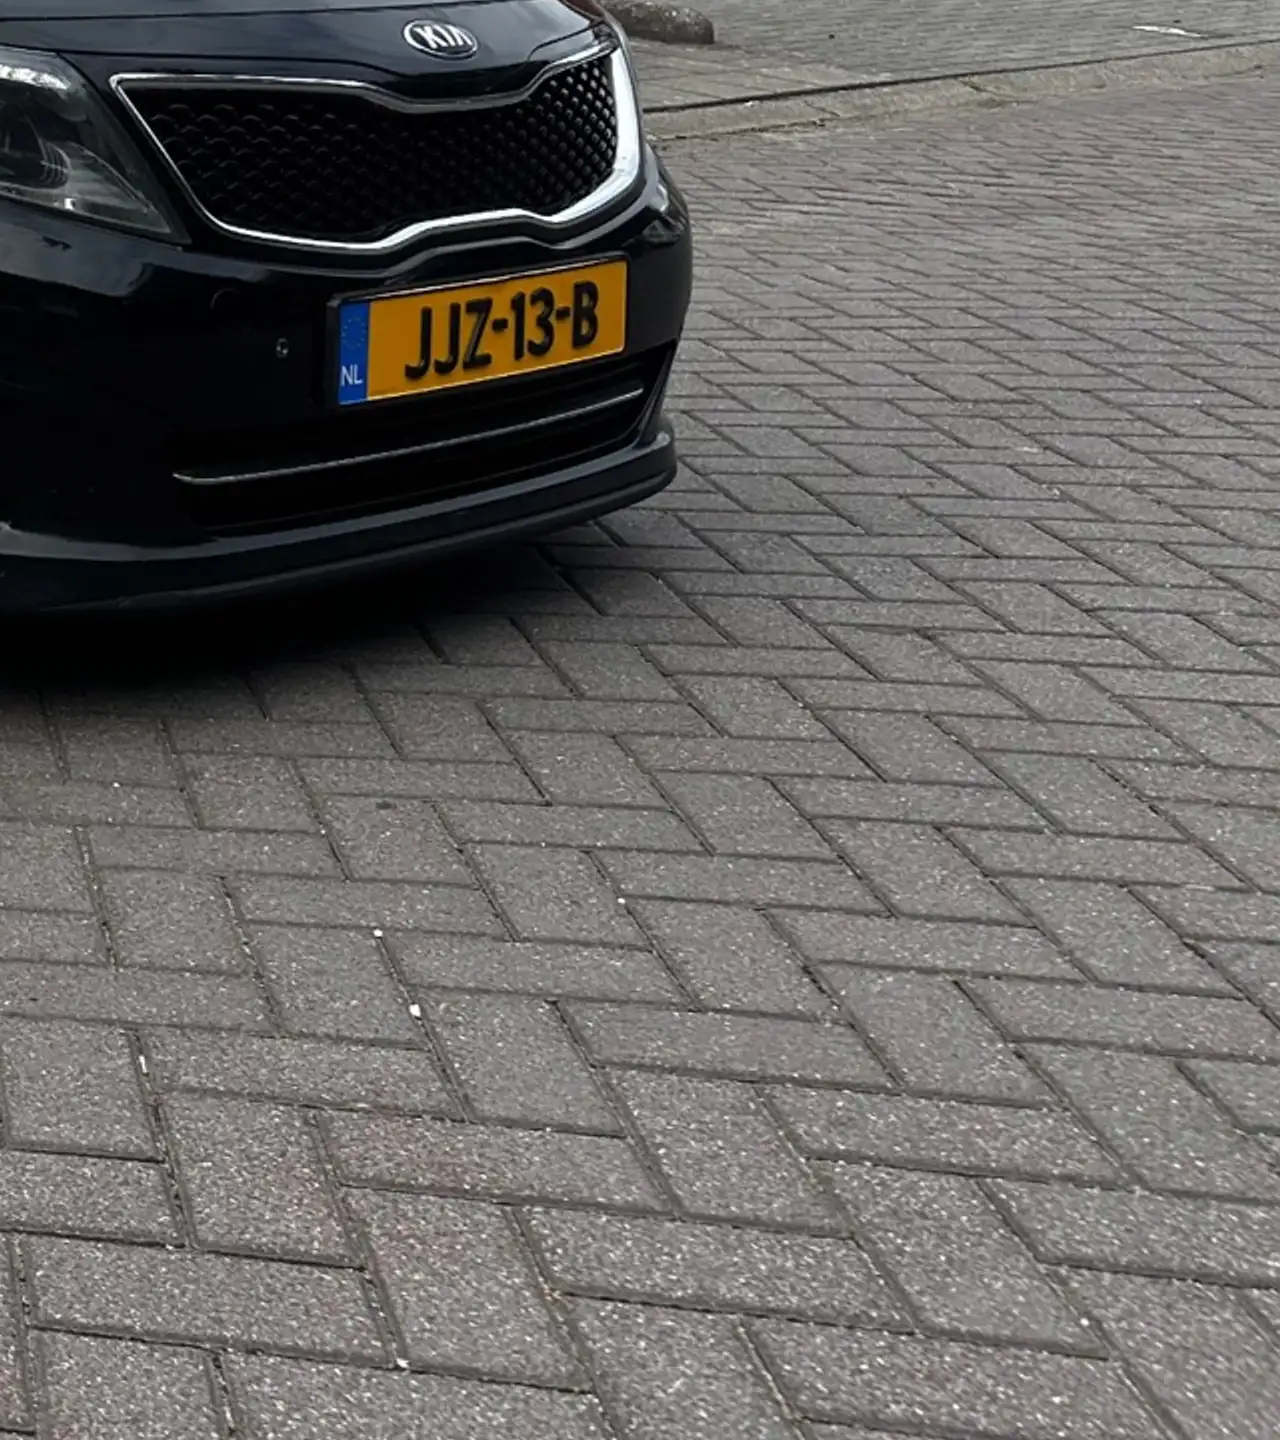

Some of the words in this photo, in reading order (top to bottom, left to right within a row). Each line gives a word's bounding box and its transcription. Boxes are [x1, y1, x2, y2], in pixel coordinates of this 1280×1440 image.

[412, 24, 474, 49] KIA
[404, 280, 600, 381] JJZ-13-B
[341, 364, 363, 387] NL
